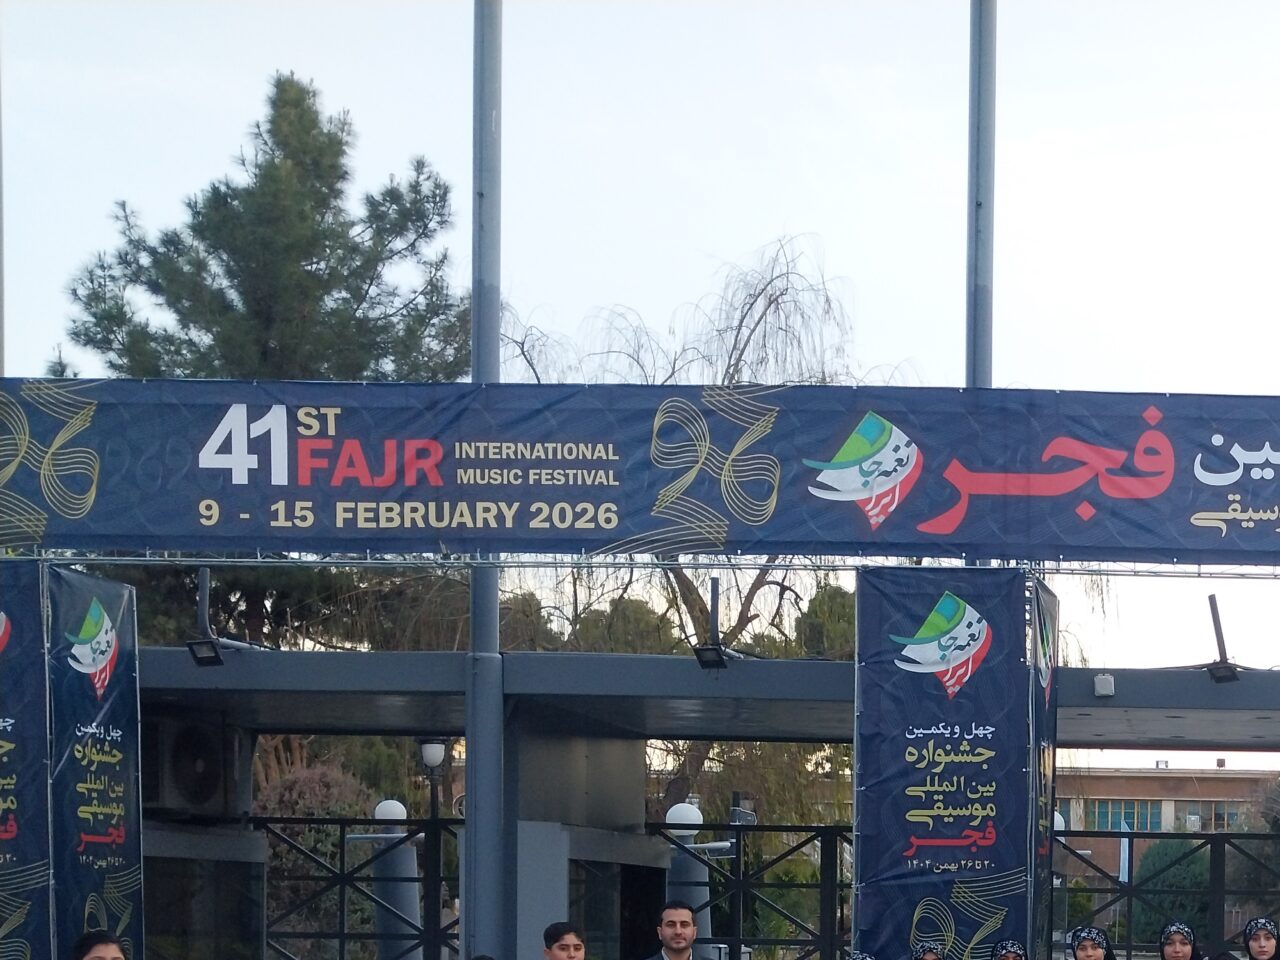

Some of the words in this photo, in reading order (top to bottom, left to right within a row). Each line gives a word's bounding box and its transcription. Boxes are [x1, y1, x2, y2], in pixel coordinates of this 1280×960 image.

[455, 442, 619, 461] INTERNATIONAL
[298, 440, 443, 486] FAJR
[916, 404, 1176, 535] فجر
[456, 468, 521, 486] MUSIC
[528, 467, 619, 486] FESTIVAL
[198, 501, 220, 527] 9
[270, 500, 315, 527] 15
[335, 501, 519, 528] FEBRUARY
[528, 501, 619, 529] 2026
[106, 725, 123, 742] چهل
[905, 722, 952, 739] یکمین
[952, 726, 961, 739] و
[964, 724, 996, 742] چهل
[74, 738, 123, 771] جشنواره
[905, 739, 996, 773] جشنواره
[905, 775, 964, 803] المللی
[966, 780, 996, 799] بین
[77, 800, 125, 826] موسیقی
[905, 799, 996, 831] موسیقی
[76, 821, 125, 852] فجر
[902, 820, 997, 857] فجر
[907, 859, 931, 869] ۱۴۰۴
[933, 862, 959, 873] بهمن
[961, 859, 973, 869] ۲۶
[975, 859, 982, 870] تا
